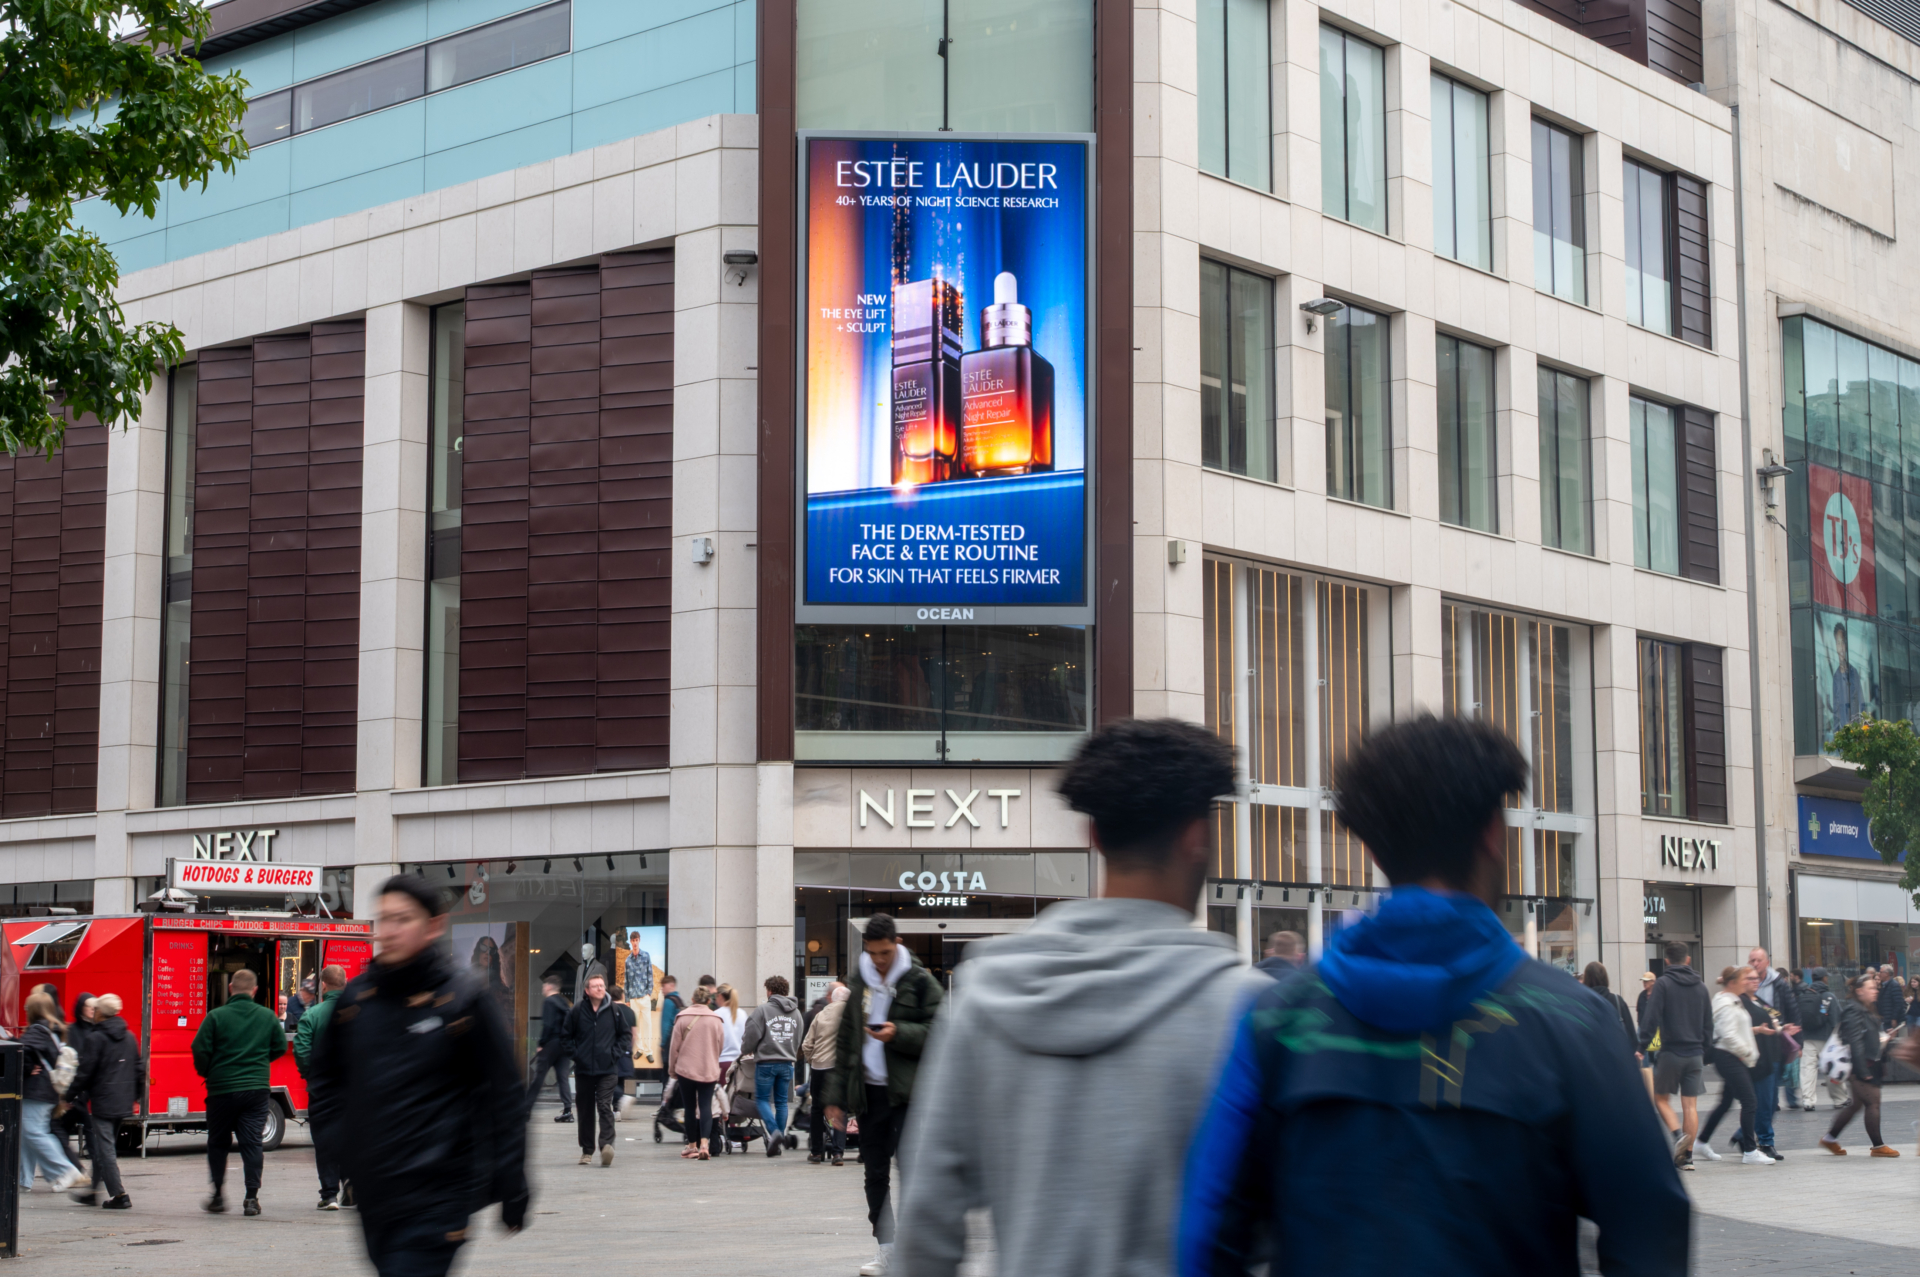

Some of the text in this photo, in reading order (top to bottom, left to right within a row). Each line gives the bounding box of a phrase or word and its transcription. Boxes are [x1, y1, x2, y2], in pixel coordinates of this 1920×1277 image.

[936, 162, 1058, 189] LAUDER
[835, 195, 1059, 209] 40+ YEARS OF NIGHT SCIENCE RESEARCH
[857, 294, 887, 306] NEW
[820, 308, 887, 320] THE EYE LIFT
[846, 322, 887, 333] SCULPT
[894, 387, 927, 400] LAUDER
[963, 379, 1004, 394] LAUDER
[963, 396, 1003, 411] Advanced
[963, 408, 1011, 424] Night Repair
[860, 523, 1025, 541] THE DERM-TESTED
[851, 543, 1039, 561] FACE & EYE ROUTINE
[829, 567, 1061, 585] FOR SKIN THAT FEELS FIRMER
[916, 608, 974, 620] OCEAN
[859, 788, 1022, 828] NEXT
[1829, 820, 1859, 839] pharmacy
[193, 829, 280, 862] NEXT
[1661, 834, 1723, 871] NEXT
[182, 865, 314, 886] HOTDOGS & BURGERS
[898, 871, 987, 893] COSTA
[918, 896, 968, 907] COFFEE
[1643, 895, 1667, 914] OSTA
[162, 918, 364, 933] BURGER CHIPS HOTDOG BURGER CHIPS HOTDOG
[169, 942, 194, 950] DRINKS
[342, 945, 367, 953] SNACKS
[169, 991, 184, 999] Pepsi
[164, 999, 184, 1007] Pepper
